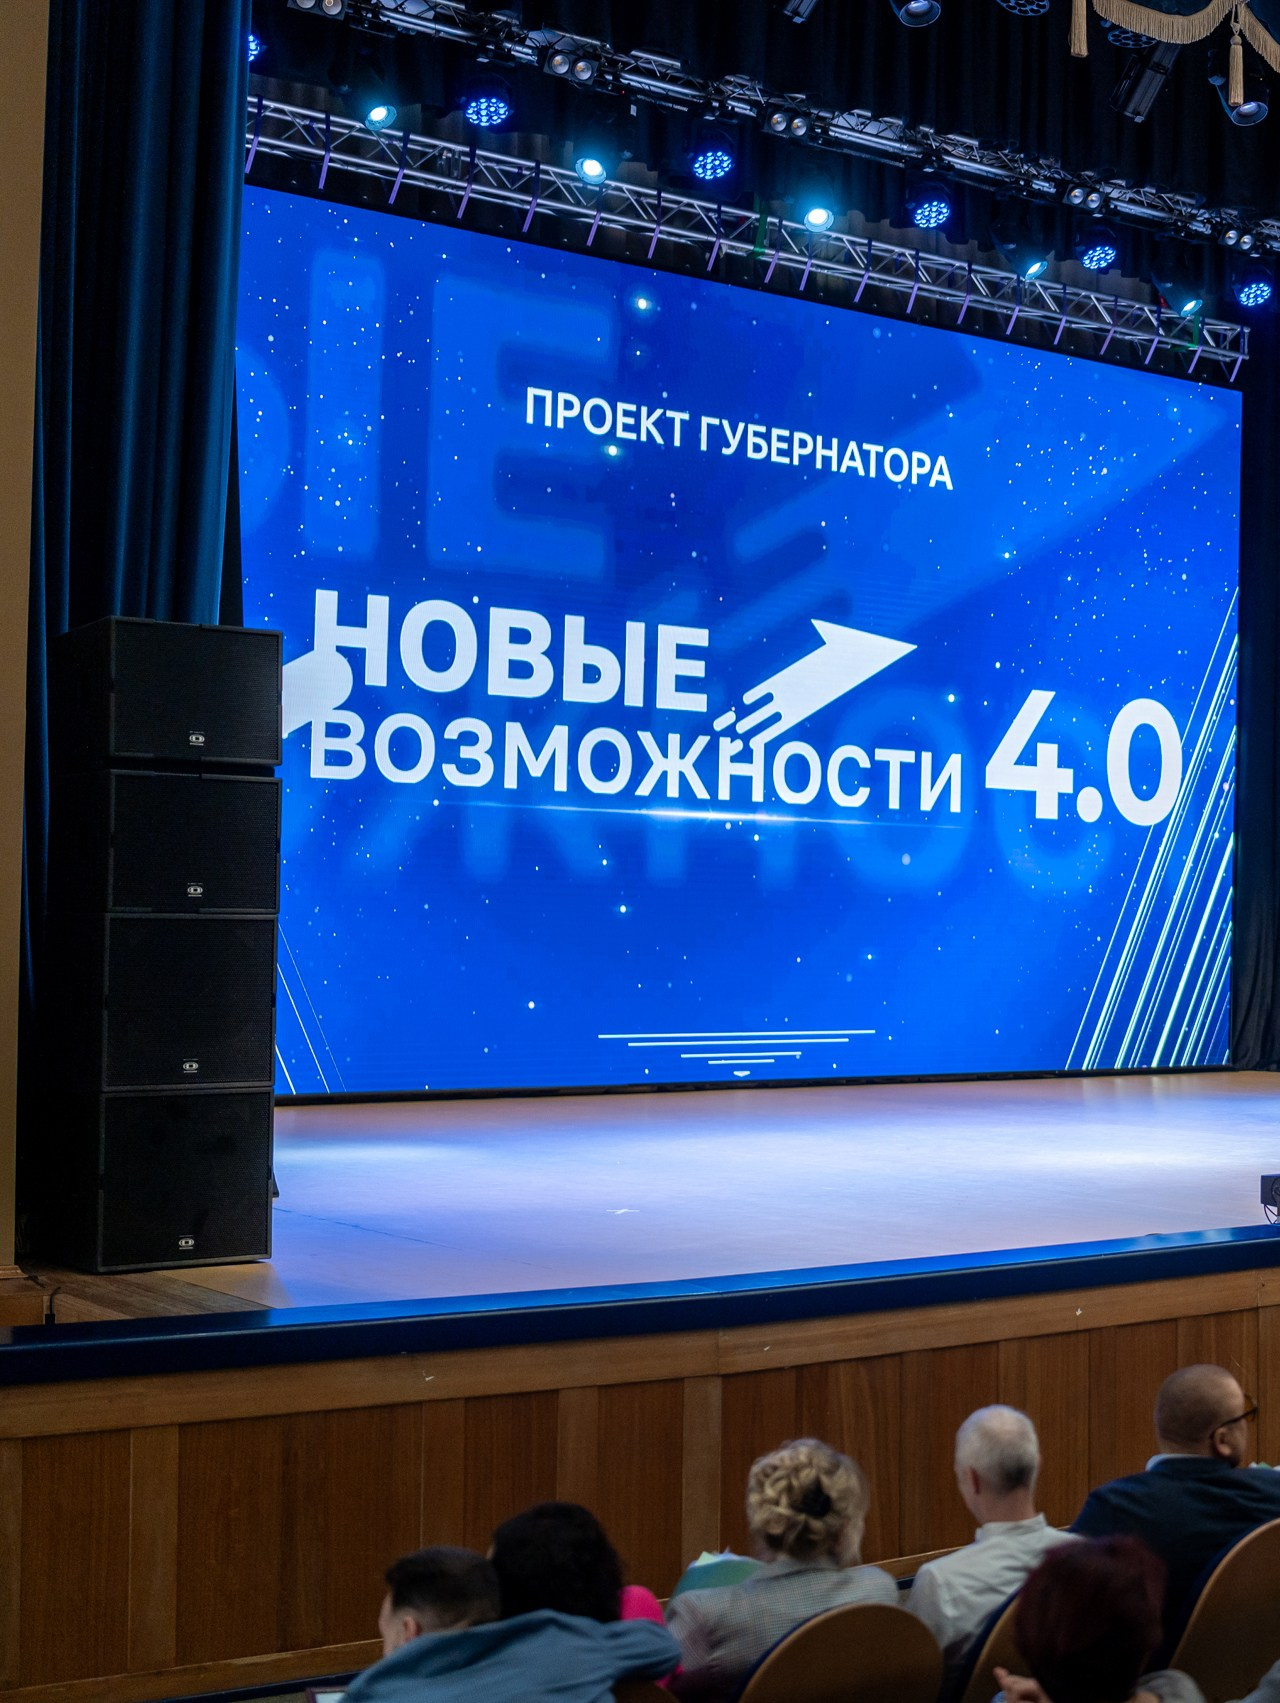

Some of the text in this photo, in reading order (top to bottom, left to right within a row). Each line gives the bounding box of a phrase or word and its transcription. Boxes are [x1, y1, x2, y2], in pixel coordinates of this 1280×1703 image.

[526, 386, 955, 492] ПРОЕКТ ГУБЕРНАТОРА
[314, 588, 711, 714] НОВЫЕ
[310, 689, 1184, 829] ВОЗМОЖНОСТИ 4.0
